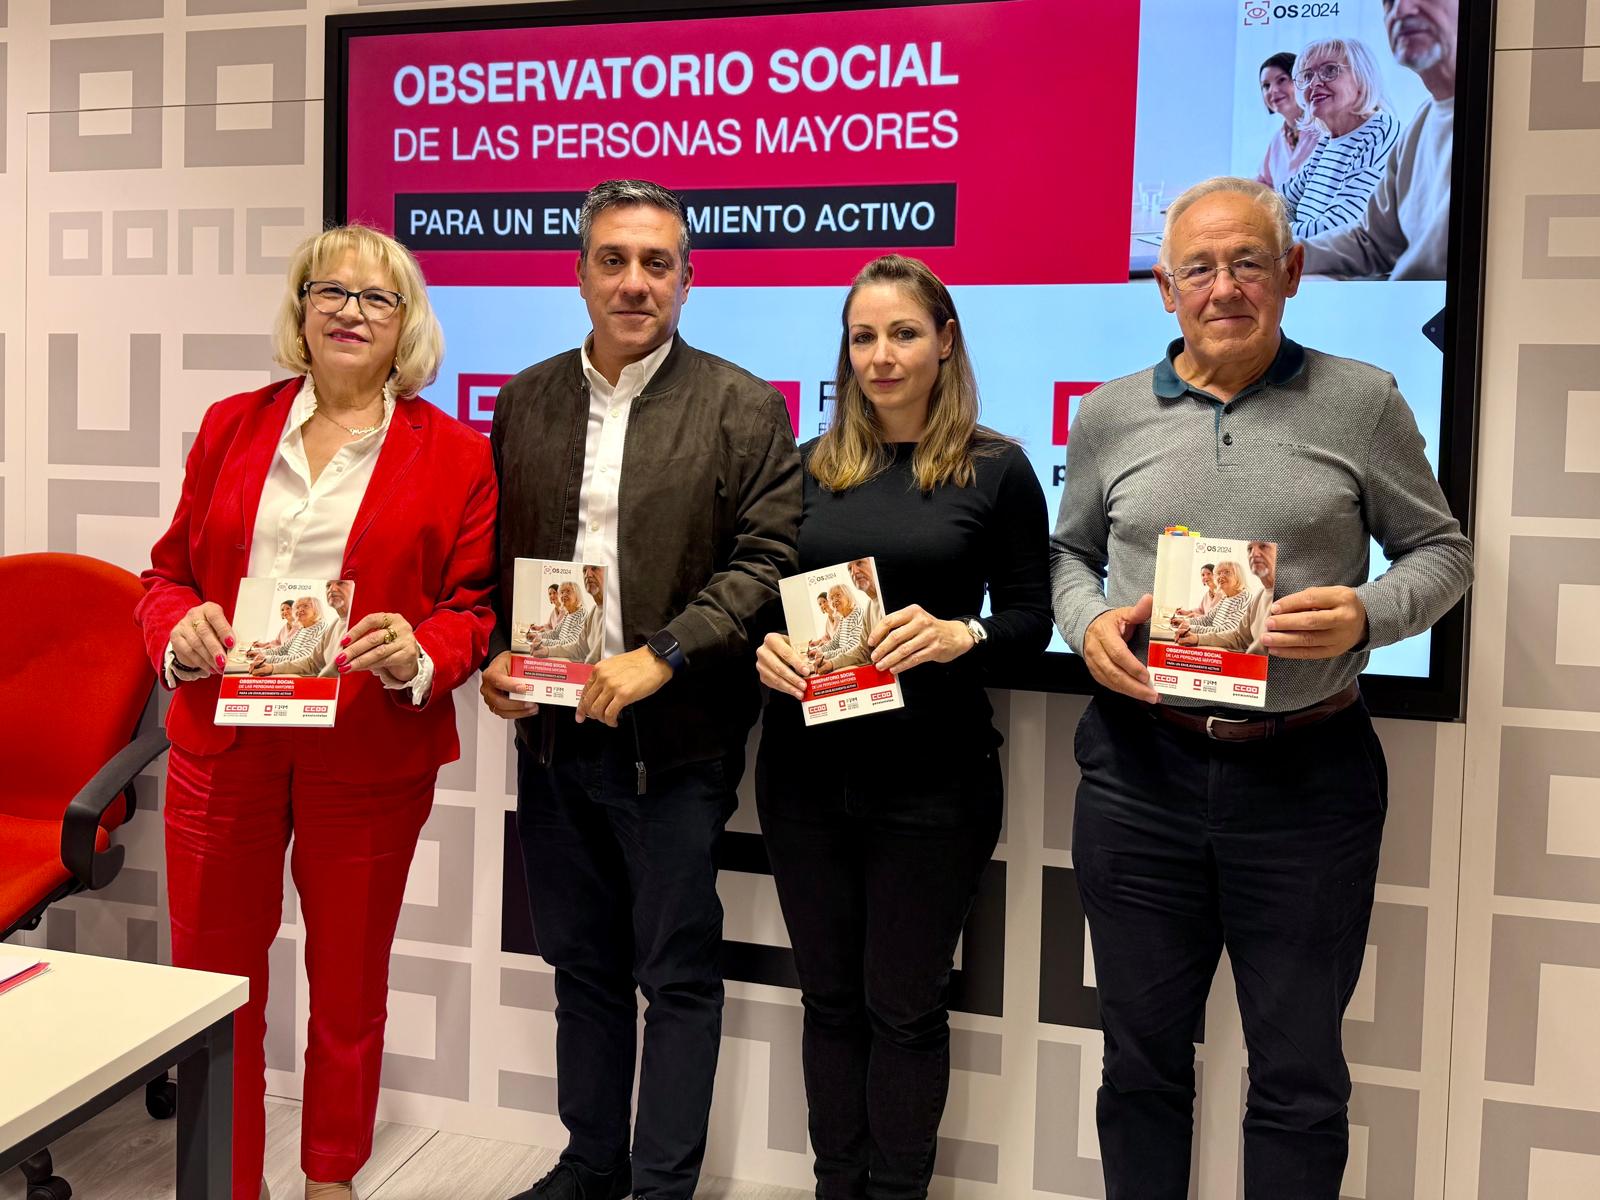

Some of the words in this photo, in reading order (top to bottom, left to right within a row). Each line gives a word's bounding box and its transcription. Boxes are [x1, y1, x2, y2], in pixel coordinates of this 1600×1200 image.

[1273, 5, 1299, 19] OS
[1301, 2, 1340, 18] 2024
[393, 51, 753, 106] OBSERVATORIO
[768, 41, 959, 94] SOCIAL
[394, 127, 440, 162] DE
[452, 125, 519, 160] LAS
[532, 118, 742, 160] PERSONAS
[755, 109, 959, 153] MAYORES
[410, 209, 484, 235] PARA
[493, 208, 533, 235] UN
[815, 201, 935, 232] ACTIVO
[1166, 648, 1203, 656] OBSERVATORIO
[1234, 684, 1258, 693] CCOO
[872, 691, 892, 701] CCOO
[809, 704, 827, 714] CCOO
